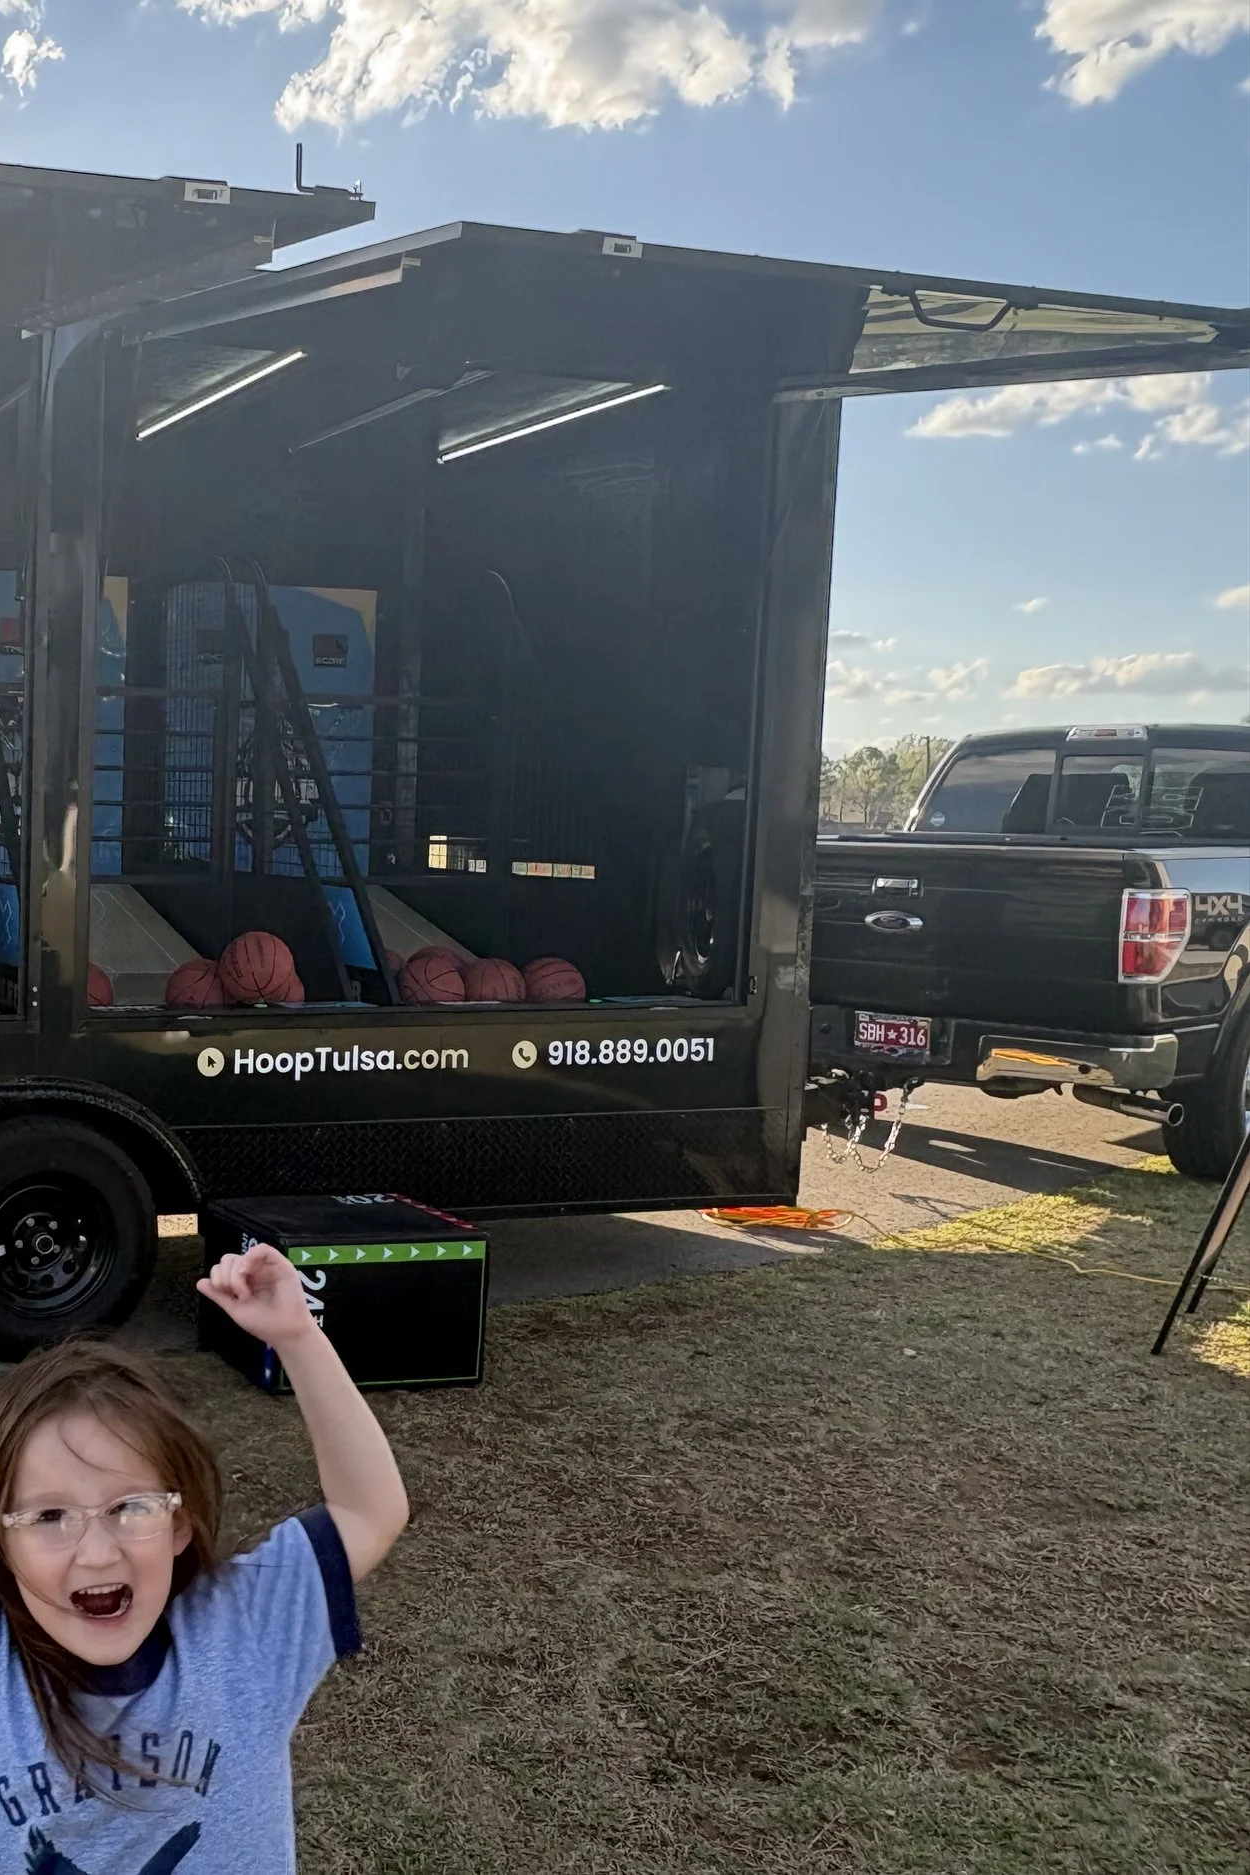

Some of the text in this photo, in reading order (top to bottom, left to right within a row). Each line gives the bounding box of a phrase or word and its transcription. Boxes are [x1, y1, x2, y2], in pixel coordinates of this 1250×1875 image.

[859, 1022, 926, 1047] SBH 316
[234, 1045, 469, 1081] HoopTulsa.com
[549, 1038, 714, 1066] 918.889.0051
